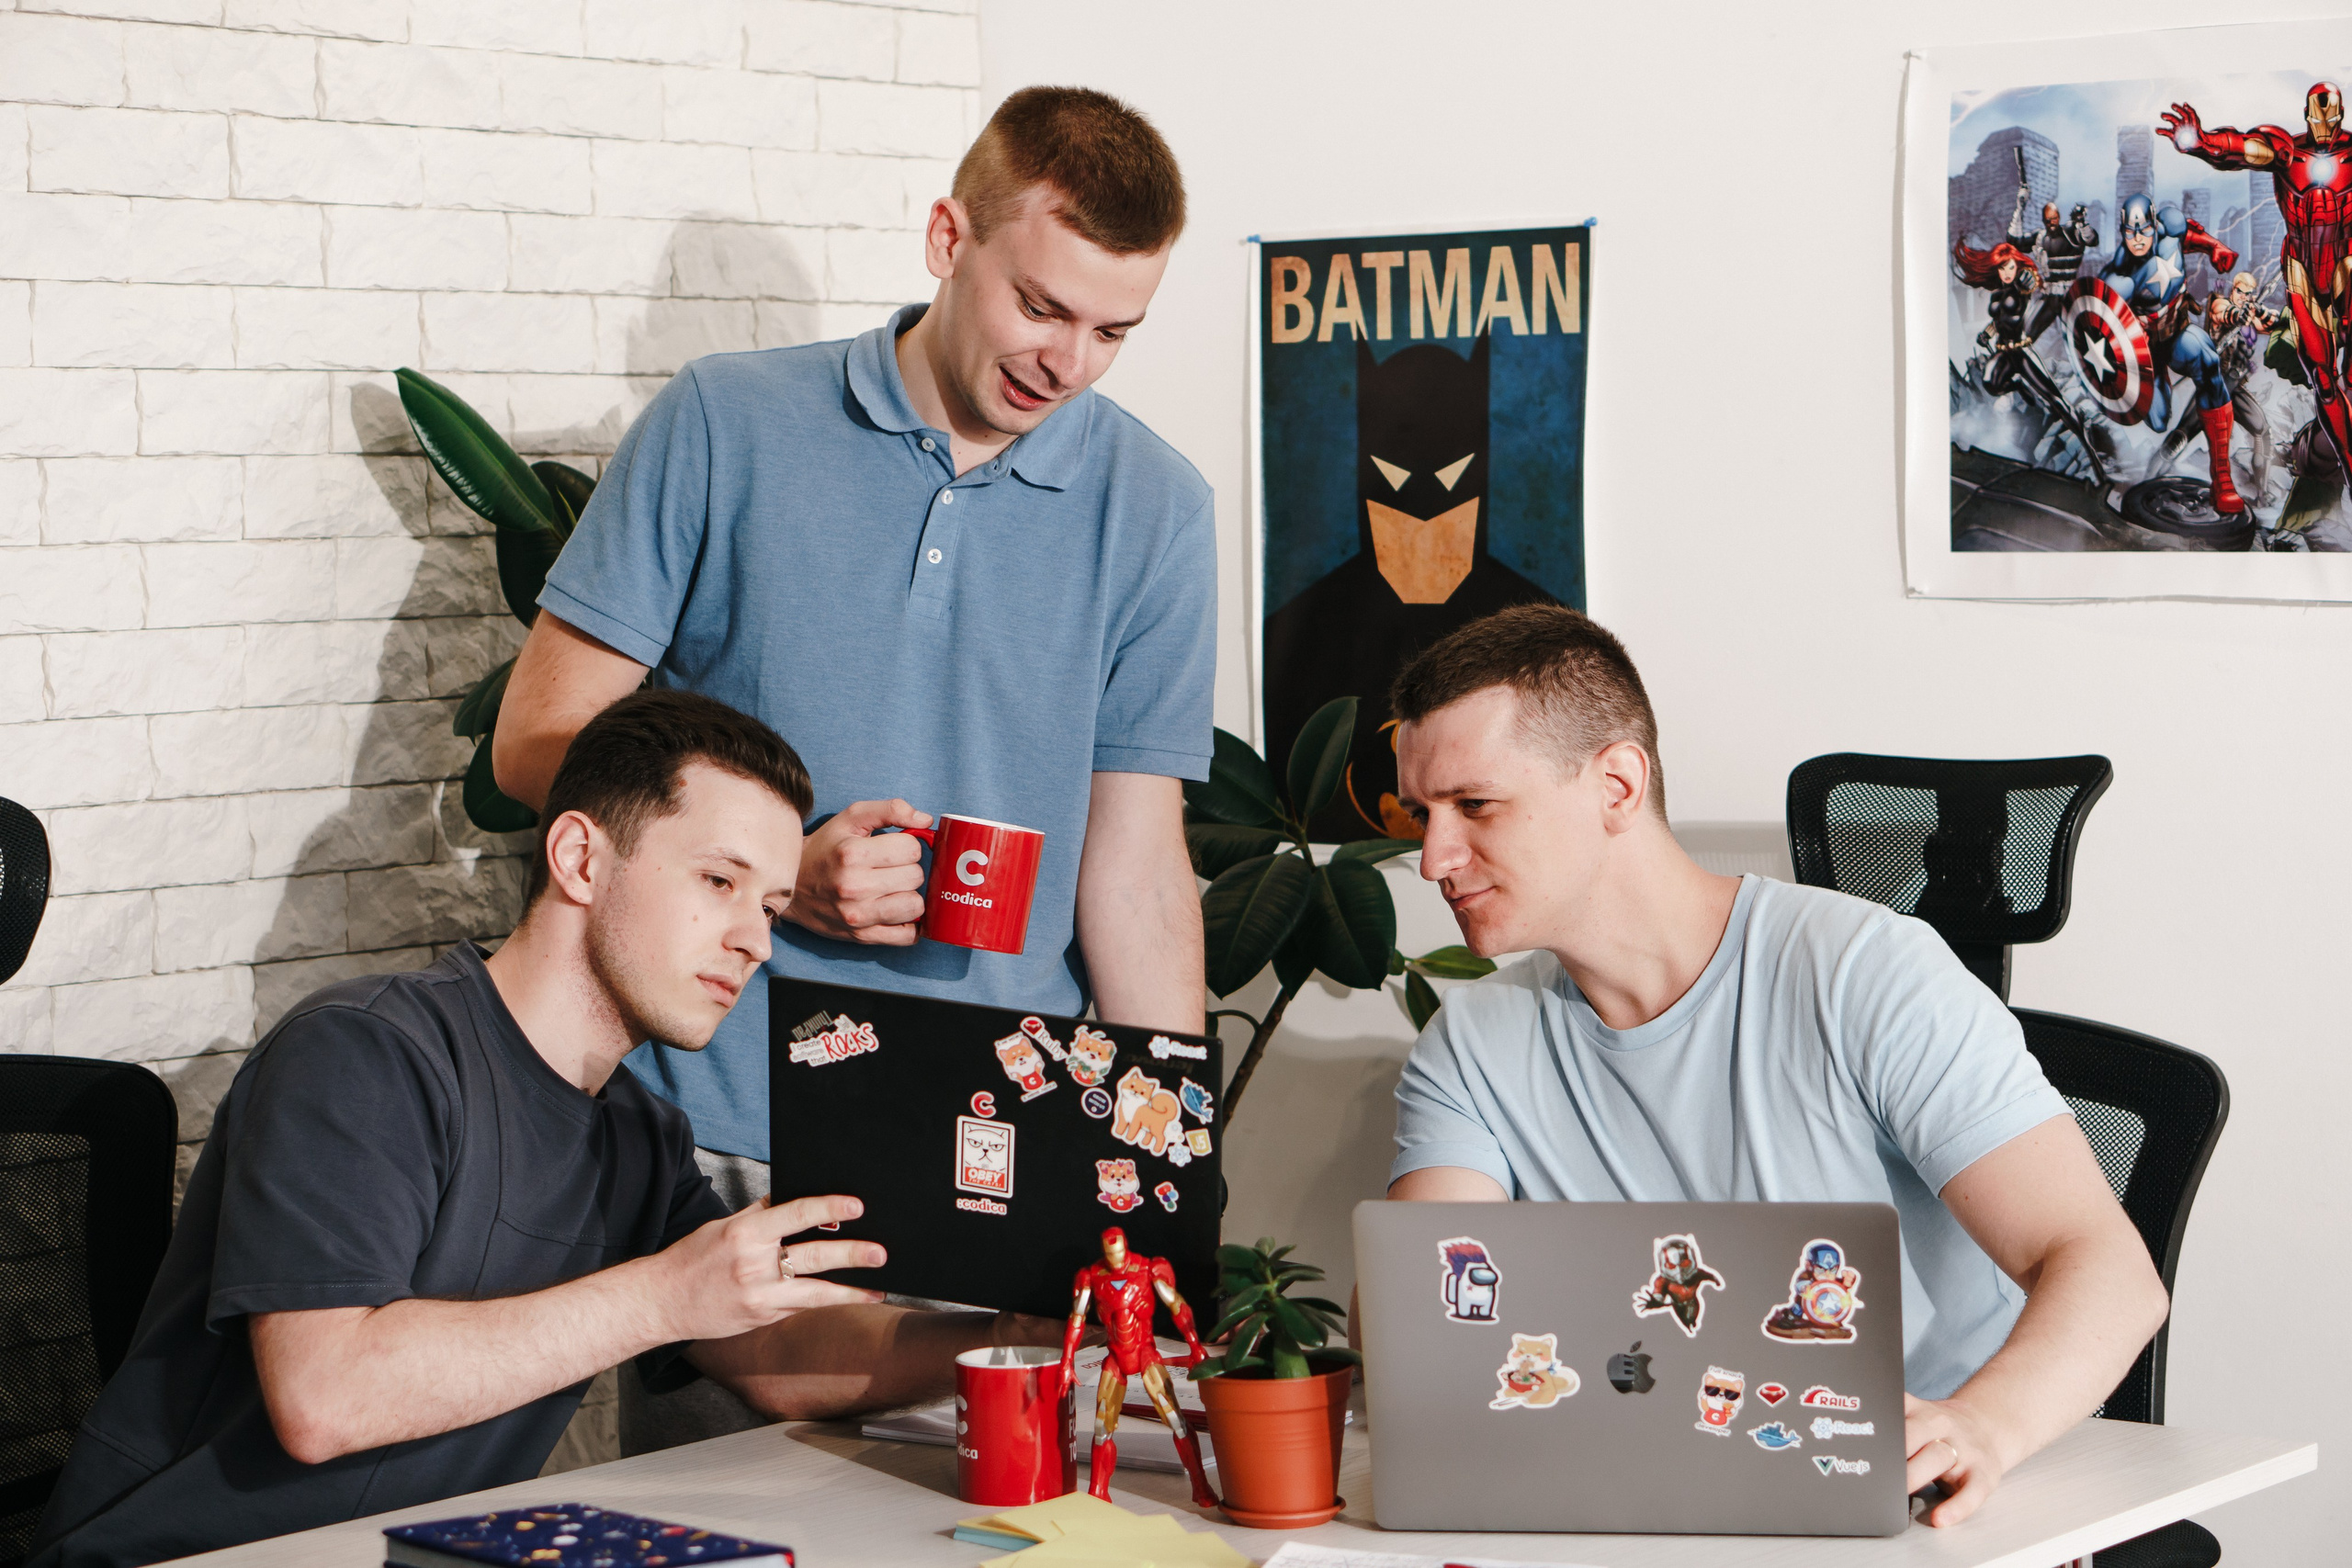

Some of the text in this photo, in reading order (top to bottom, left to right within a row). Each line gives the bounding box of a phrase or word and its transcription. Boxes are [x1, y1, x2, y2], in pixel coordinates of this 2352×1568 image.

[1271, 243, 1581, 344] BATMAN
[956, 849, 989, 886] C
[791, 1010, 833, 1042] ThinkPad
[797, 1039, 822, 1051] create
[821, 1025, 876, 1059] ROCKS
[1037, 1031, 1066, 1059] Ruby
[810, 1055, 827, 1066] that
[973, 1093, 994, 1116] C
[1195, 1134, 1207, 1151] JS
[967, 1168, 1001, 1183] OBEY
[958, 1199, 1006, 1213] :codica
[1819, 1395, 1858, 1408] RAILS
[1836, 1422, 1874, 1434] React
[958, 1442, 978, 1460] dica
